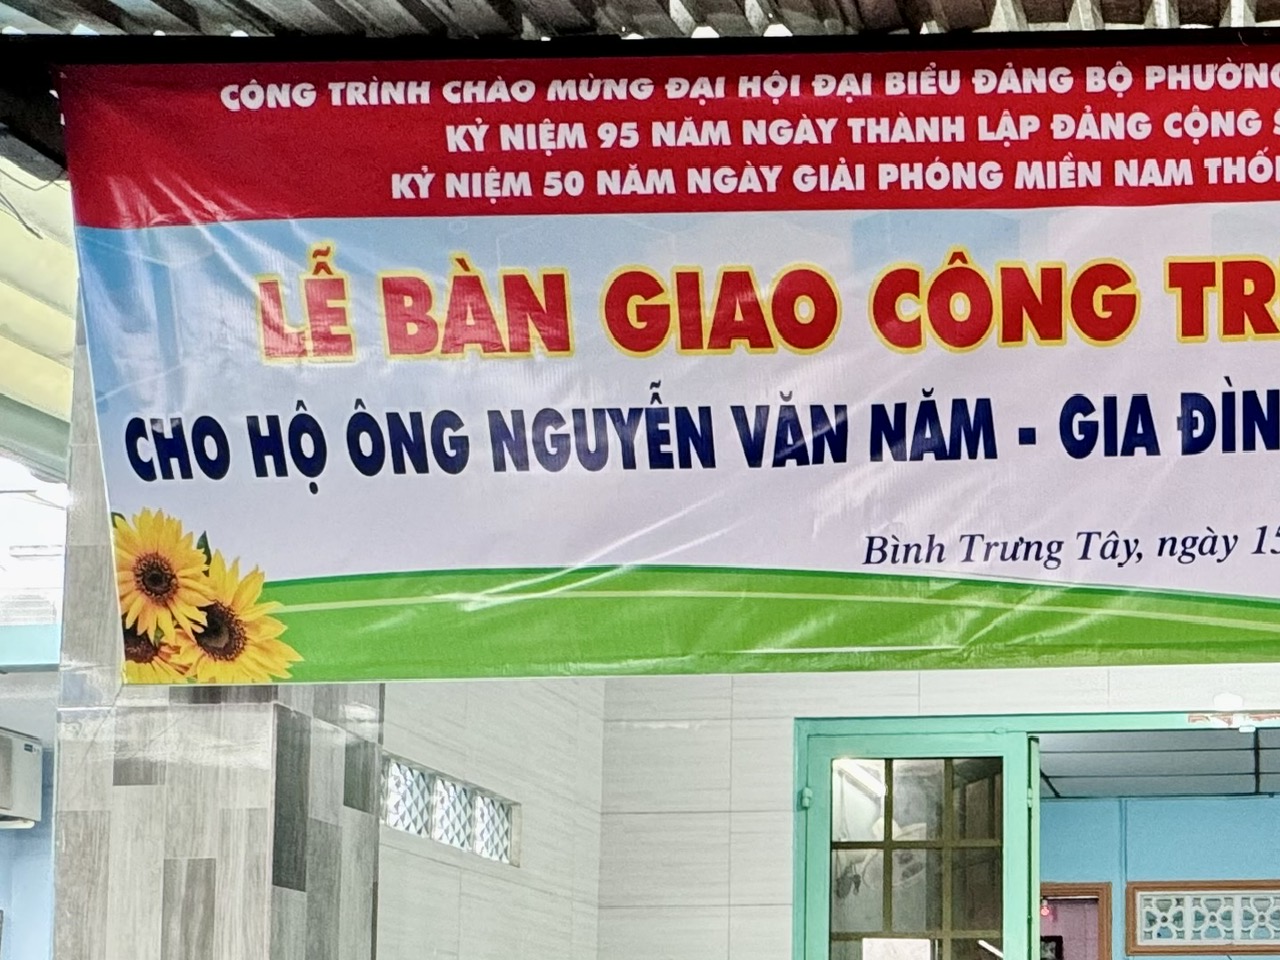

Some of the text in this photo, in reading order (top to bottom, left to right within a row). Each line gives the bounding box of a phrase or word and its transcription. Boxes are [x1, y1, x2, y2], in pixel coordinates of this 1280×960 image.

[220, 79, 316, 112] CÔNG
[328, 76, 430, 106] TRÌNH
[442, 75, 535, 104] CHÀO
[547, 74, 653, 101] MỪNG
[665, 76, 724, 106] ĐẠI
[739, 70, 799, 105] HỘI
[812, 73, 872, 104] ĐẠI
[885, 62, 960, 96] BIỂU
[972, 61, 1074, 94] ĐẢNG
[1085, 60, 1133, 99] BỘ
[446, 117, 489, 153] KỶ
[500, 119, 588, 157] NIỆM
[597, 122, 639, 149] 95
[651, 117, 731, 148] NĂM
[742, 114, 839, 145] NGÀY
[847, 111, 966, 144] THÀNH
[978, 110, 1040, 147] LẬP
[1050, 105, 1153, 141] ĐẢNG
[1163, 105, 1262, 145] CỘNG
[391, 165, 435, 199] KỶ
[445, 165, 532, 205] NIỆM
[543, 171, 585, 197] 50
[596, 164, 675, 195] NĂM
[687, 160, 783, 194] NGÀY
[792, 157, 865, 192] GIẢI
[878, 157, 1004, 191] PHÓNG
[1015, 152, 1101, 190] MIỀN
[1114, 159, 1194, 187] NAM
[256, 240, 358, 364] LỄ
[380, 250, 574, 360] BÀN
[602, 263, 841, 358] GIAO
[869, 243, 1141, 354] CÔNG
[124, 413, 231, 482] CHO
[247, 399, 328, 494] HỘ
[346, 398, 471, 477] ÔNG
[487, 380, 717, 473] NGUYỄN
[730, 390, 848, 469] VĂN
[869, 387, 998, 463] NĂM
[1018, 427, 1037, 445] -
[1058, 393, 1161, 460] GIA
[862, 534, 946, 565] Bình
[959, 533, 1065, 570] Trưng
[1075, 530, 1144, 567] Tây,
[1156, 526, 1239, 564] ngày
